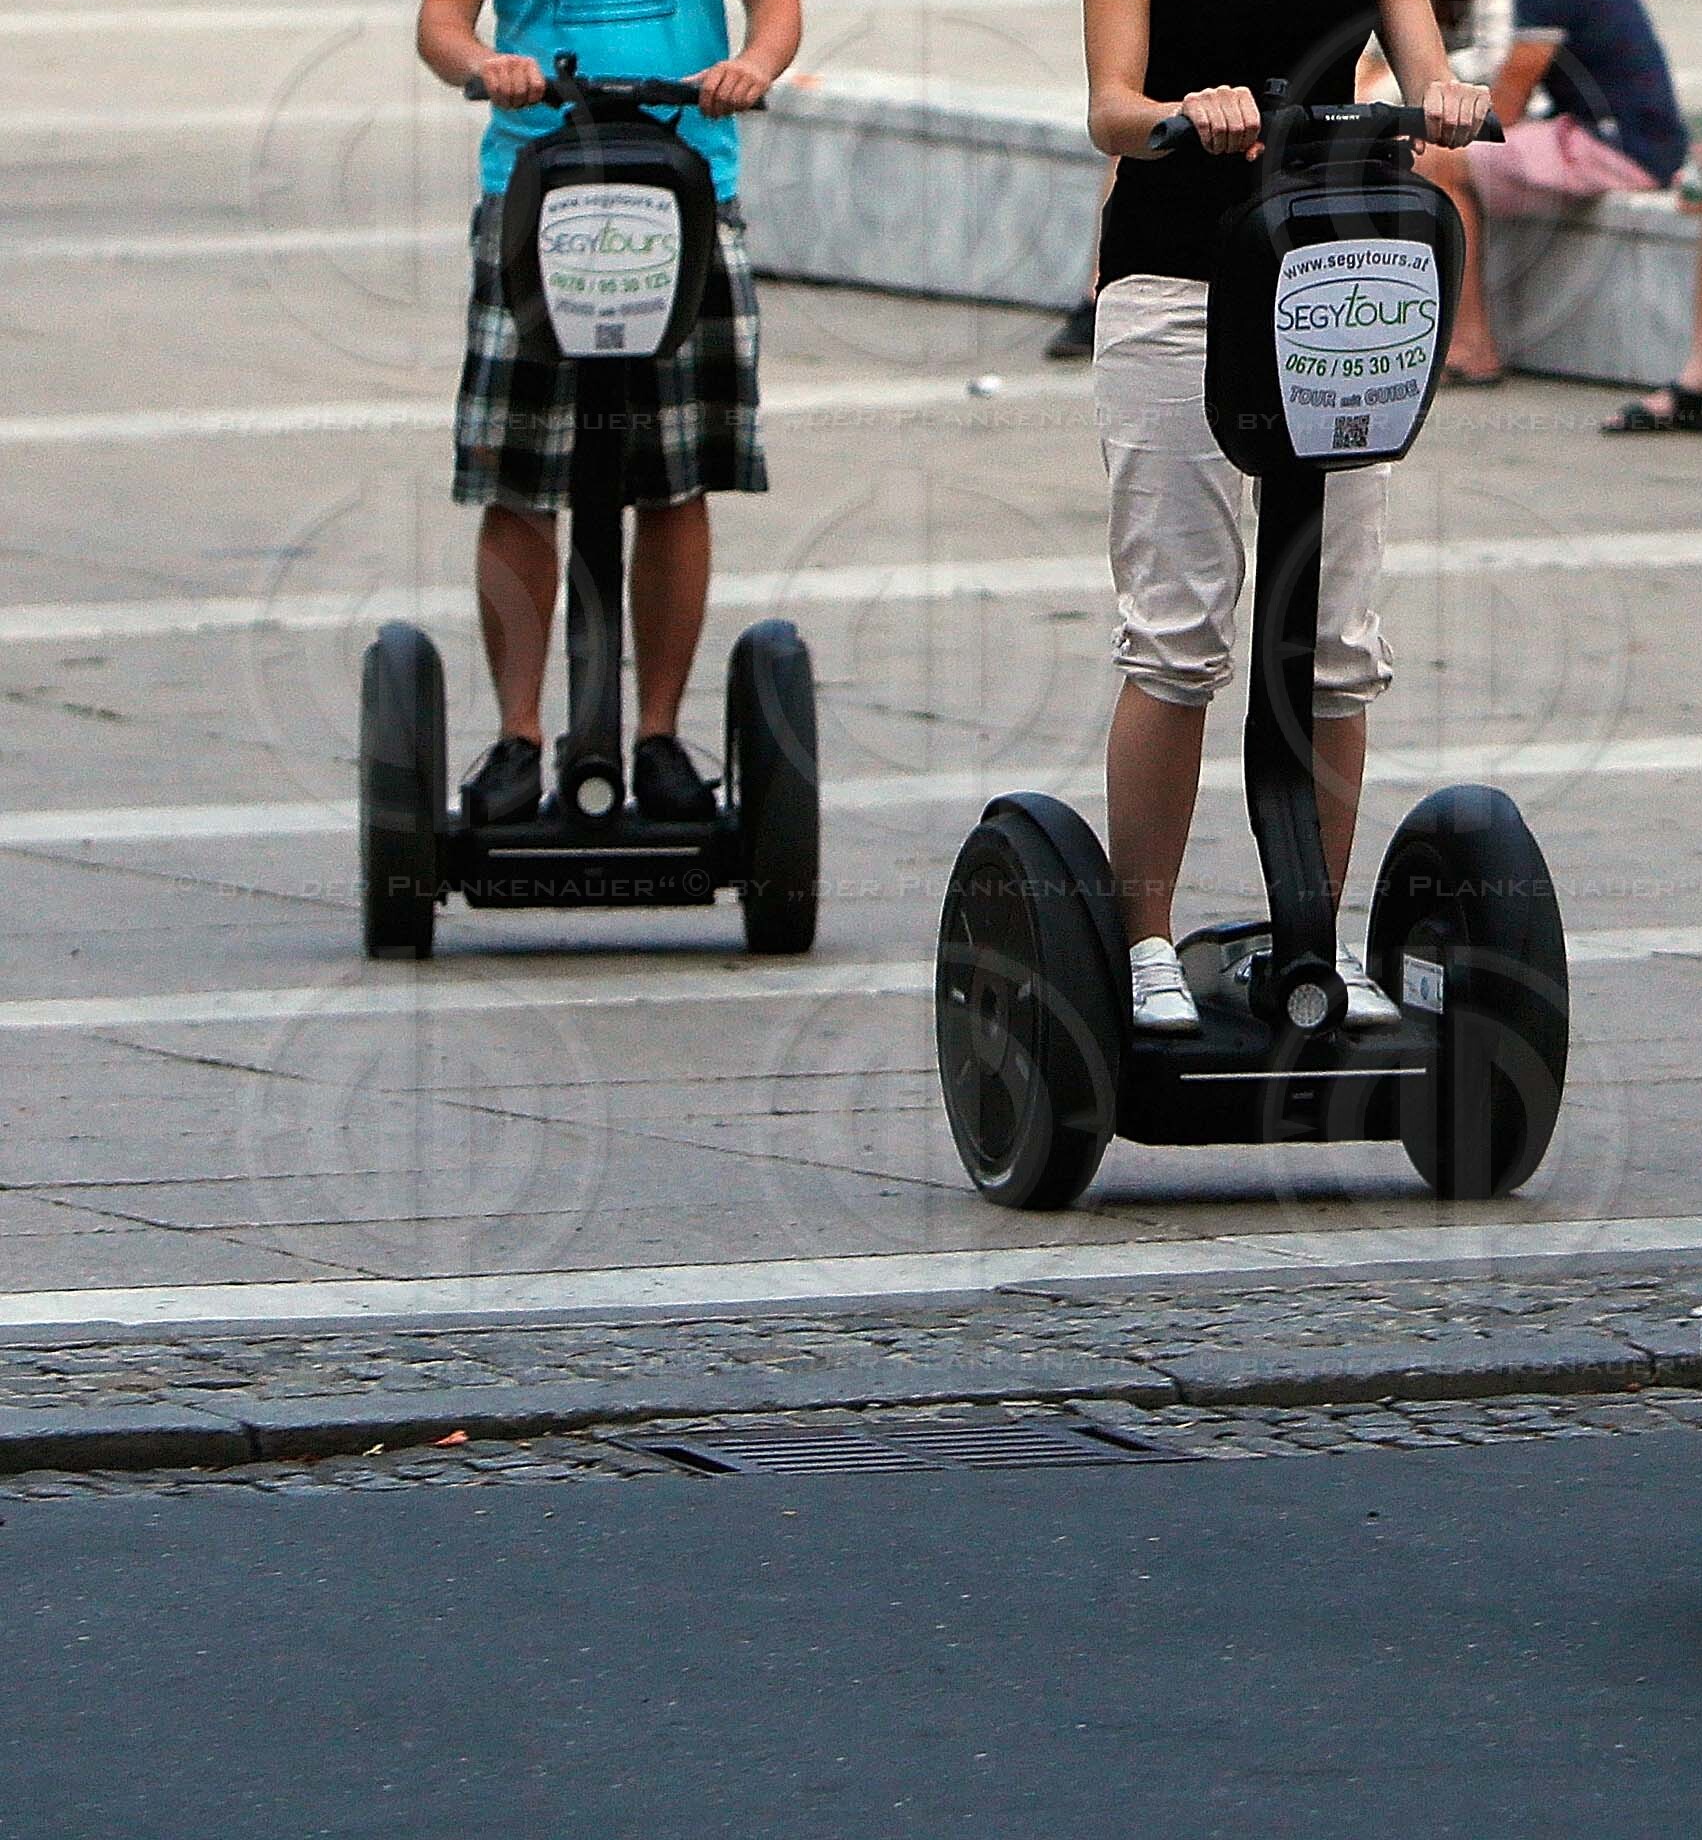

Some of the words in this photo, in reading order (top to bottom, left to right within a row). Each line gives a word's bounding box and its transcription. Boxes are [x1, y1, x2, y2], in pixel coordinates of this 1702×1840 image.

[1283, 250, 1429, 279] www.segytours.at
[1285, 353, 1327, 377] 0676
[1342, 359, 1363, 377] 95
[1369, 355, 1390, 374] 30
[1395, 346, 1426, 371] 123
[1289, 384, 1336, 408] TOUR
[1364, 379, 1420, 406] GUIDE
